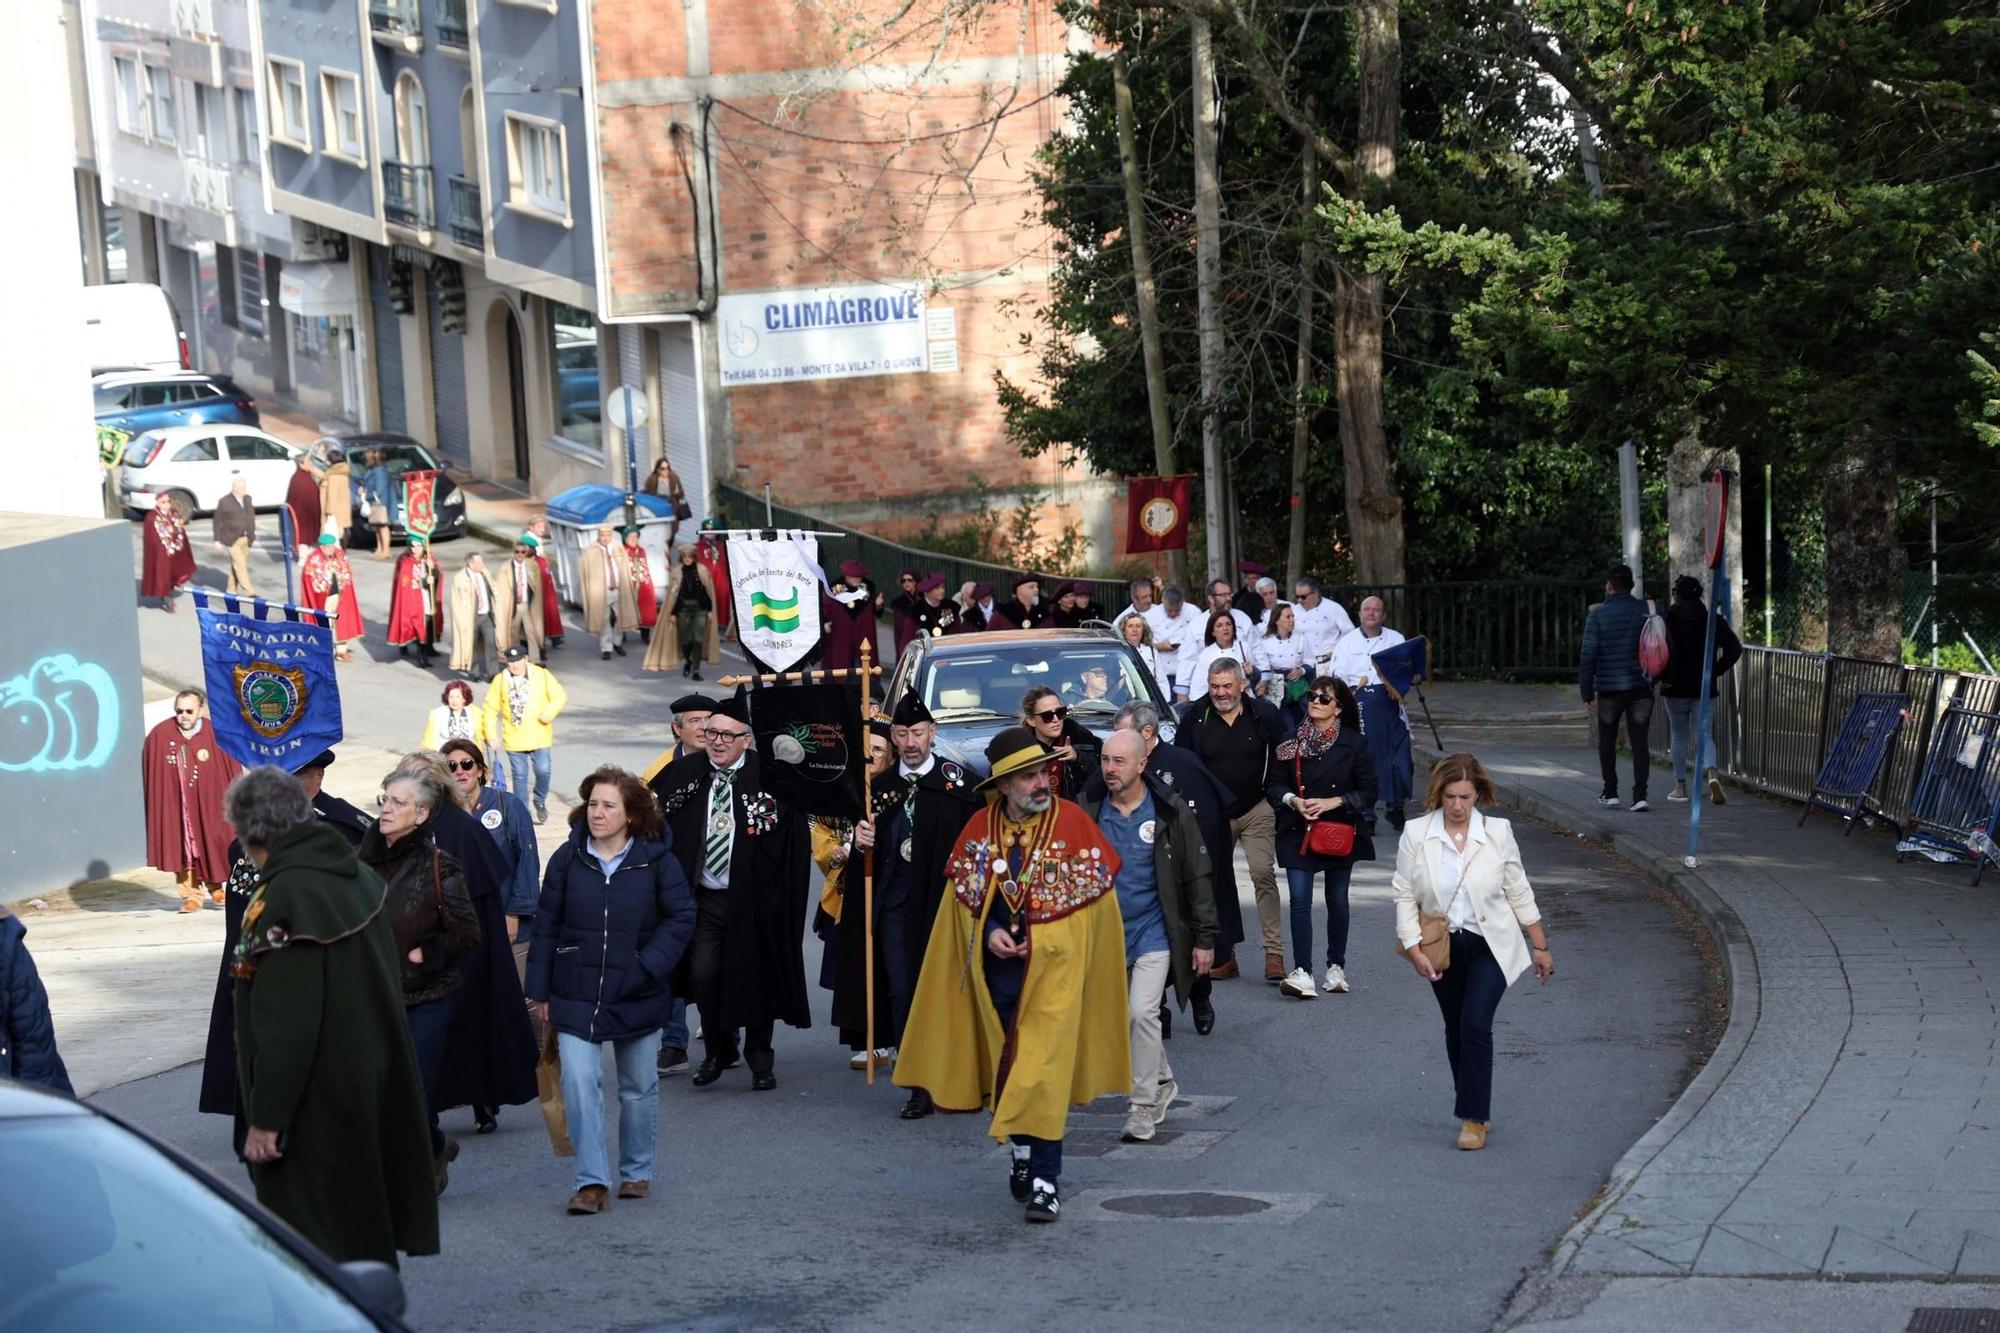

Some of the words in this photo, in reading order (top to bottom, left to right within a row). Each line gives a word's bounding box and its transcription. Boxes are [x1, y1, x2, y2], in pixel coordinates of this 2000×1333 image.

[765, 293, 919, 330] CLIMAGROVE
[801, 363, 832, 375] MONTE
[215, 622, 319, 646] COFRADIA
[228, 639, 308, 660] ANAKA
[249, 738, 302, 757] IRUN
